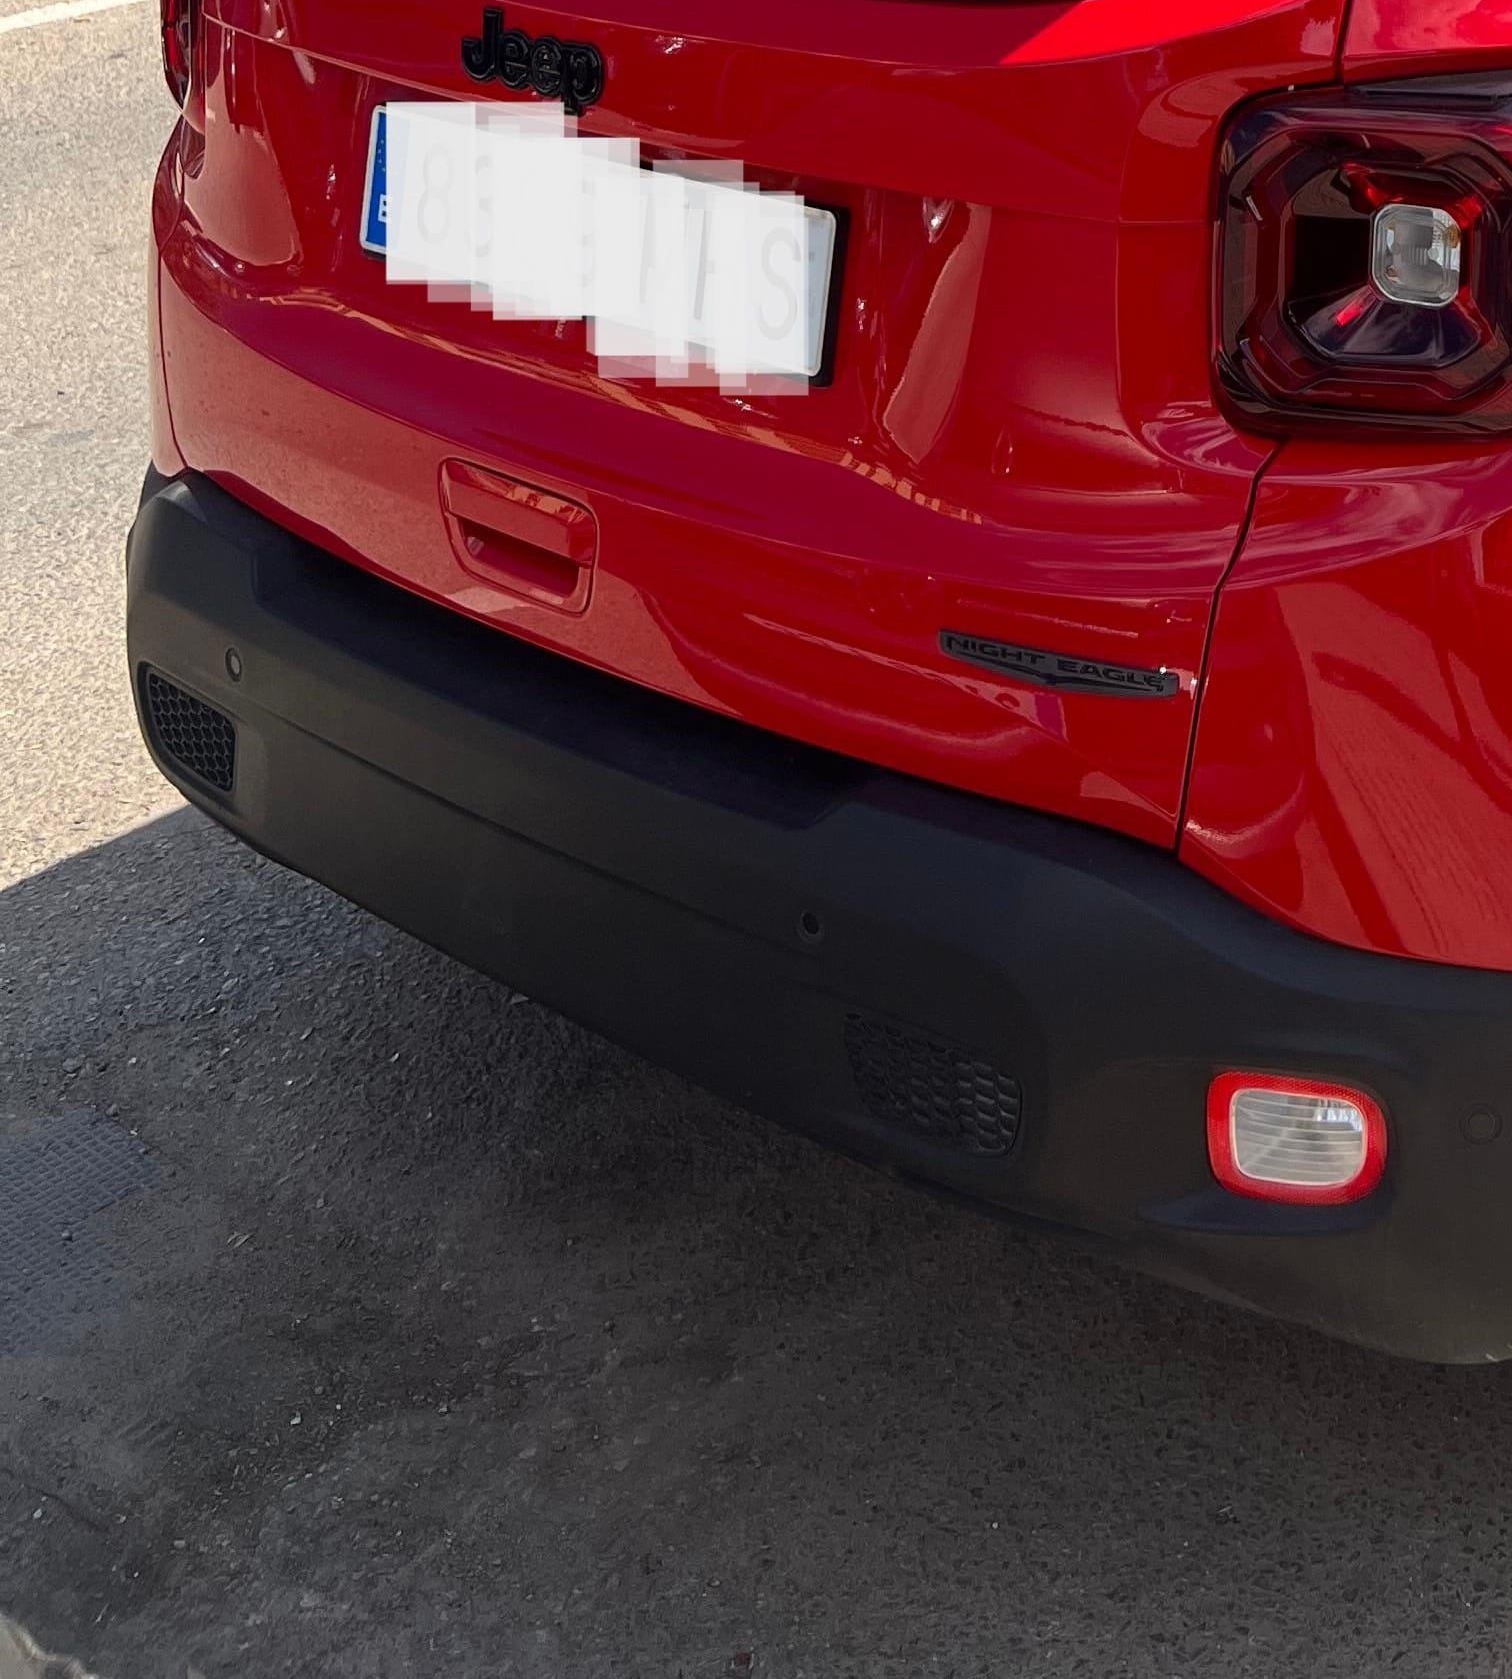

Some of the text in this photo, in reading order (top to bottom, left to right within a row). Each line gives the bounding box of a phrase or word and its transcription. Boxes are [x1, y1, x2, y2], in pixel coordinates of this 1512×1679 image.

[461, 6, 604, 117] Jeep
[946, 635, 1165, 690] NIGHT EAGLE
